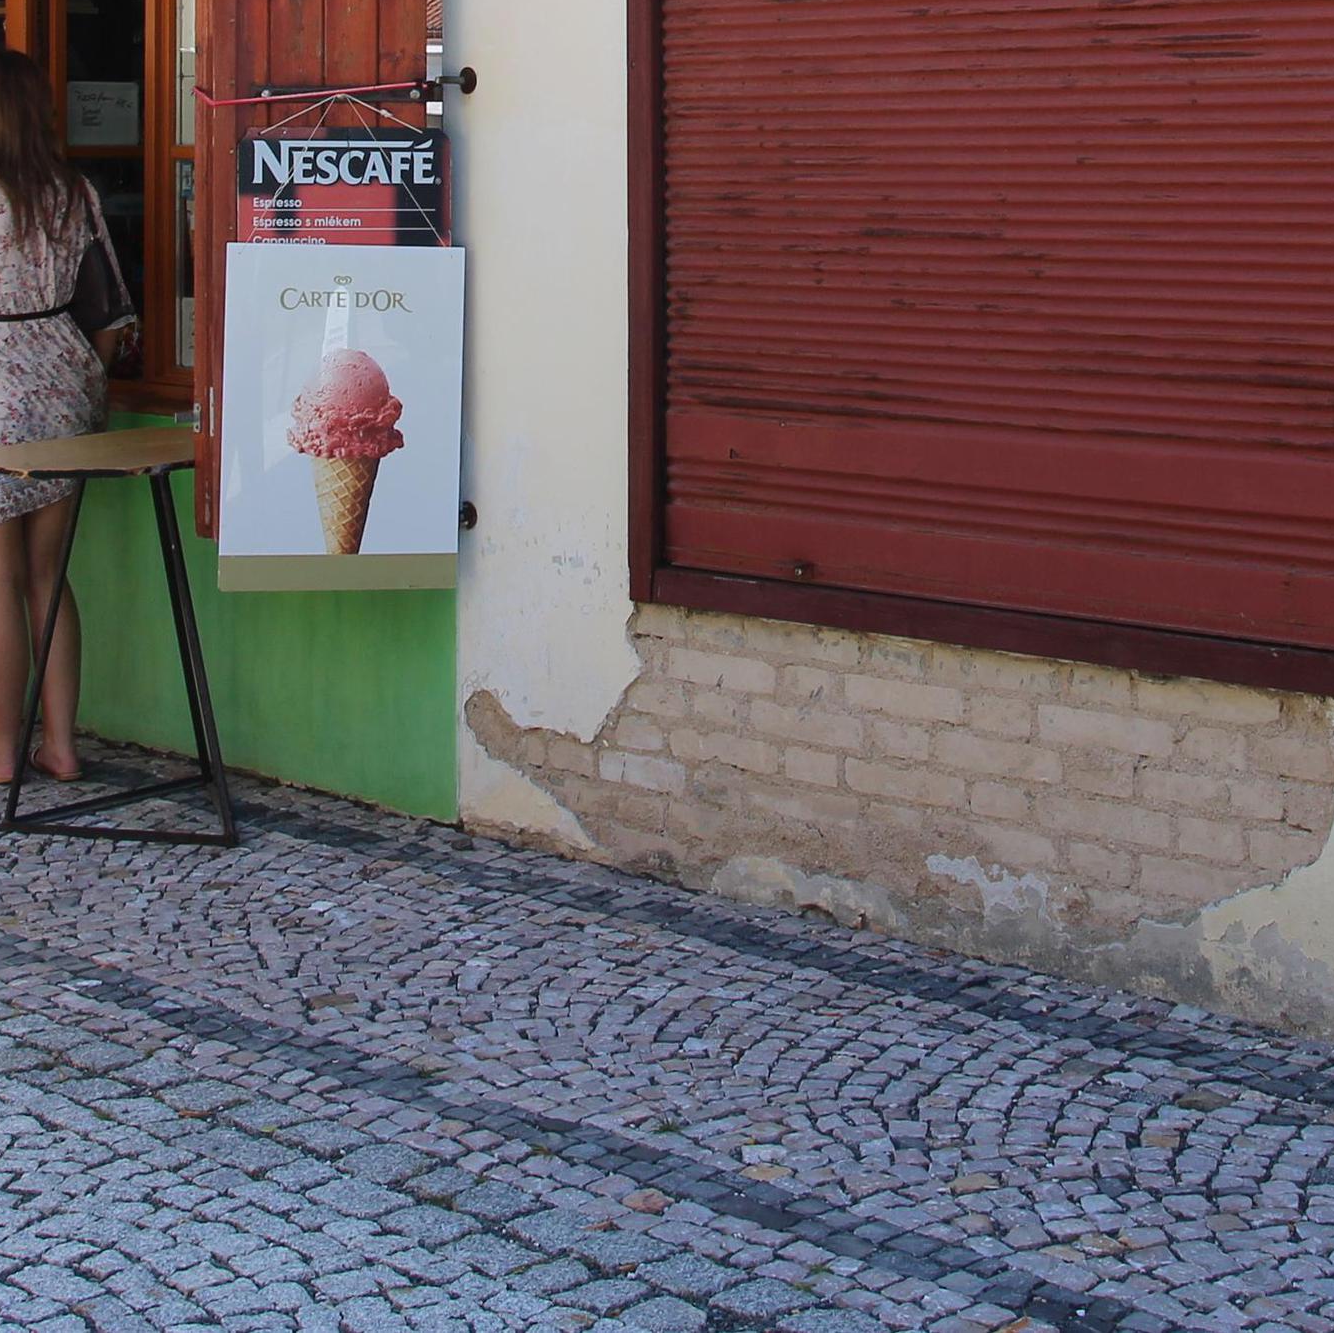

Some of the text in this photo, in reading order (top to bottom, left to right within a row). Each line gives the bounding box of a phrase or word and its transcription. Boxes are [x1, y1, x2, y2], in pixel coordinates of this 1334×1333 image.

[252, 139, 436, 185] NESCAFÉ
[253, 198, 302, 210] Espresso
[253, 216, 361, 229] Espresso s mlékem
[280, 287, 413, 313] CARTE D'OR
